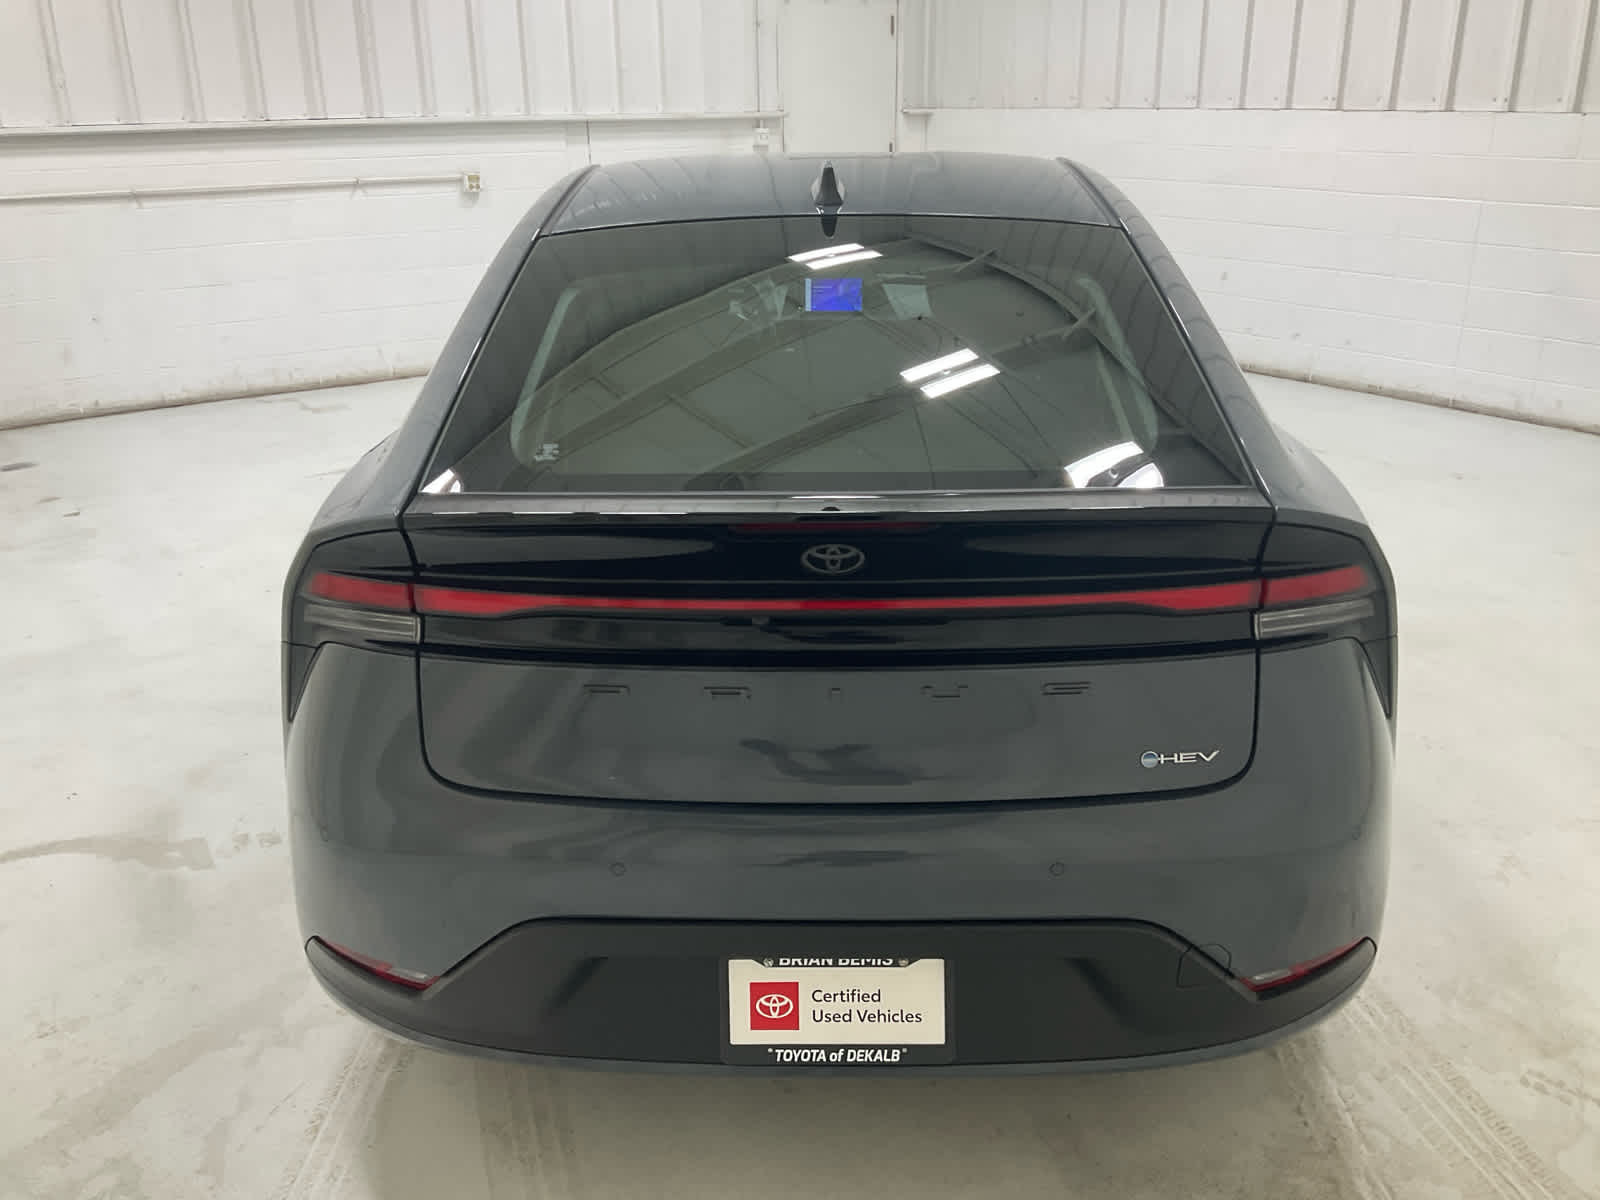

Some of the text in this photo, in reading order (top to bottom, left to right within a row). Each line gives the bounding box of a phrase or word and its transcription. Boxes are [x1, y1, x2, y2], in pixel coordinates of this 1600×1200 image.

[1160, 750, 1220, 764] HEV
[811, 988, 881, 1003] Certified
[812, 1008, 923, 1023] Used Vehicles
[775, 1048, 901, 1062] TOYOTA of DEKALB
